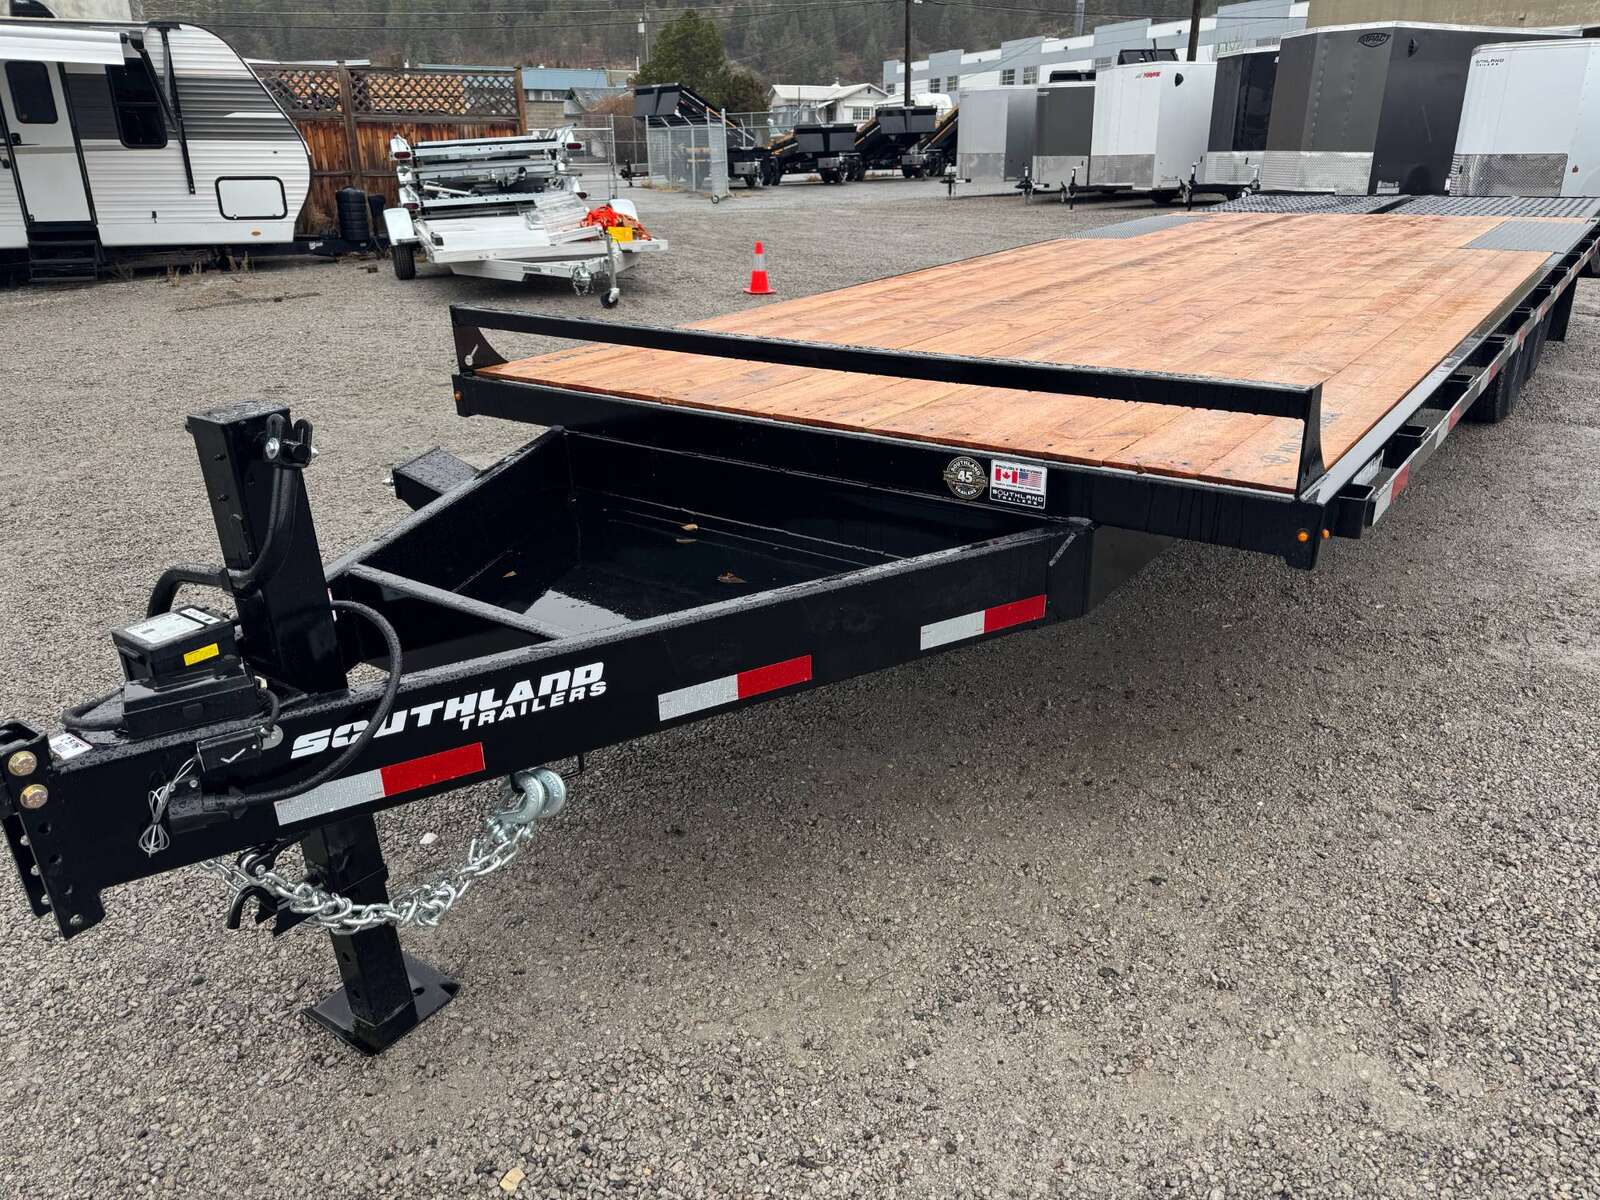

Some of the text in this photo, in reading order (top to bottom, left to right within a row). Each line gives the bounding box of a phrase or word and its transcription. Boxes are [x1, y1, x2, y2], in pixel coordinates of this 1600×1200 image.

[950, 460, 981, 476] SOUTHLAND
[957, 470, 973, 483] 45
[992, 488, 1044, 503] SOUTHLAND
[997, 494, 1038, 506] TRAILERS
[290, 662, 605, 759] SOUTHLAND
[459, 680, 607, 731] TRAILERS
